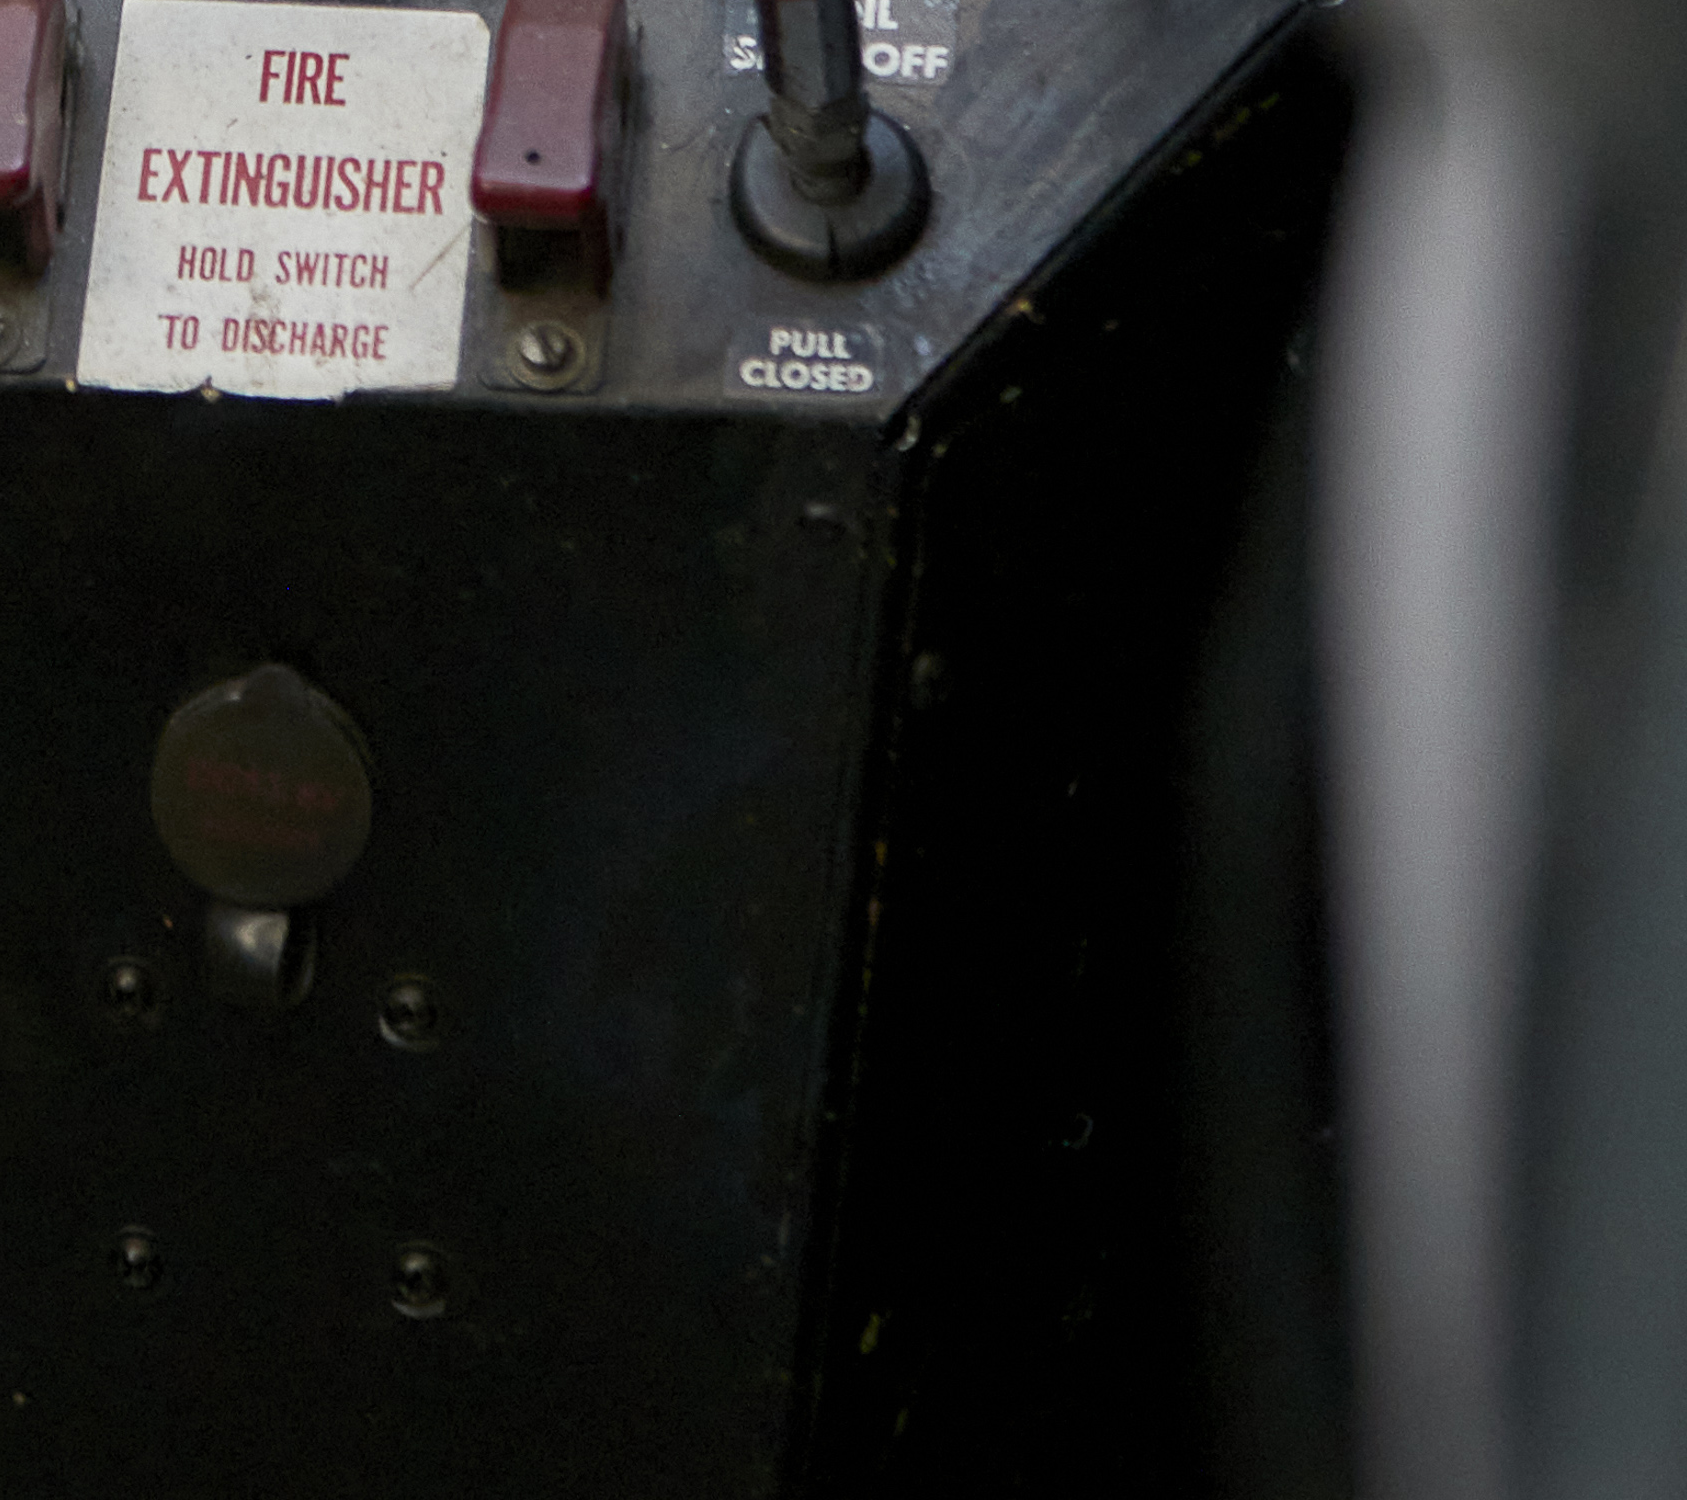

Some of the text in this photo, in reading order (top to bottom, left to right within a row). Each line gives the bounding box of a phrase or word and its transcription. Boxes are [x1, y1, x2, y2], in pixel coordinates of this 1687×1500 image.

[259, 50, 350, 107] FIRE
[138, 148, 445, 215] EXTINGUISHER
[177, 246, 389, 288] HOLD SWITCH
[158, 315, 389, 360] TO DISCHARGE
[769, 330, 851, 359] PULL
[740, 360, 874, 392] CLOSED
